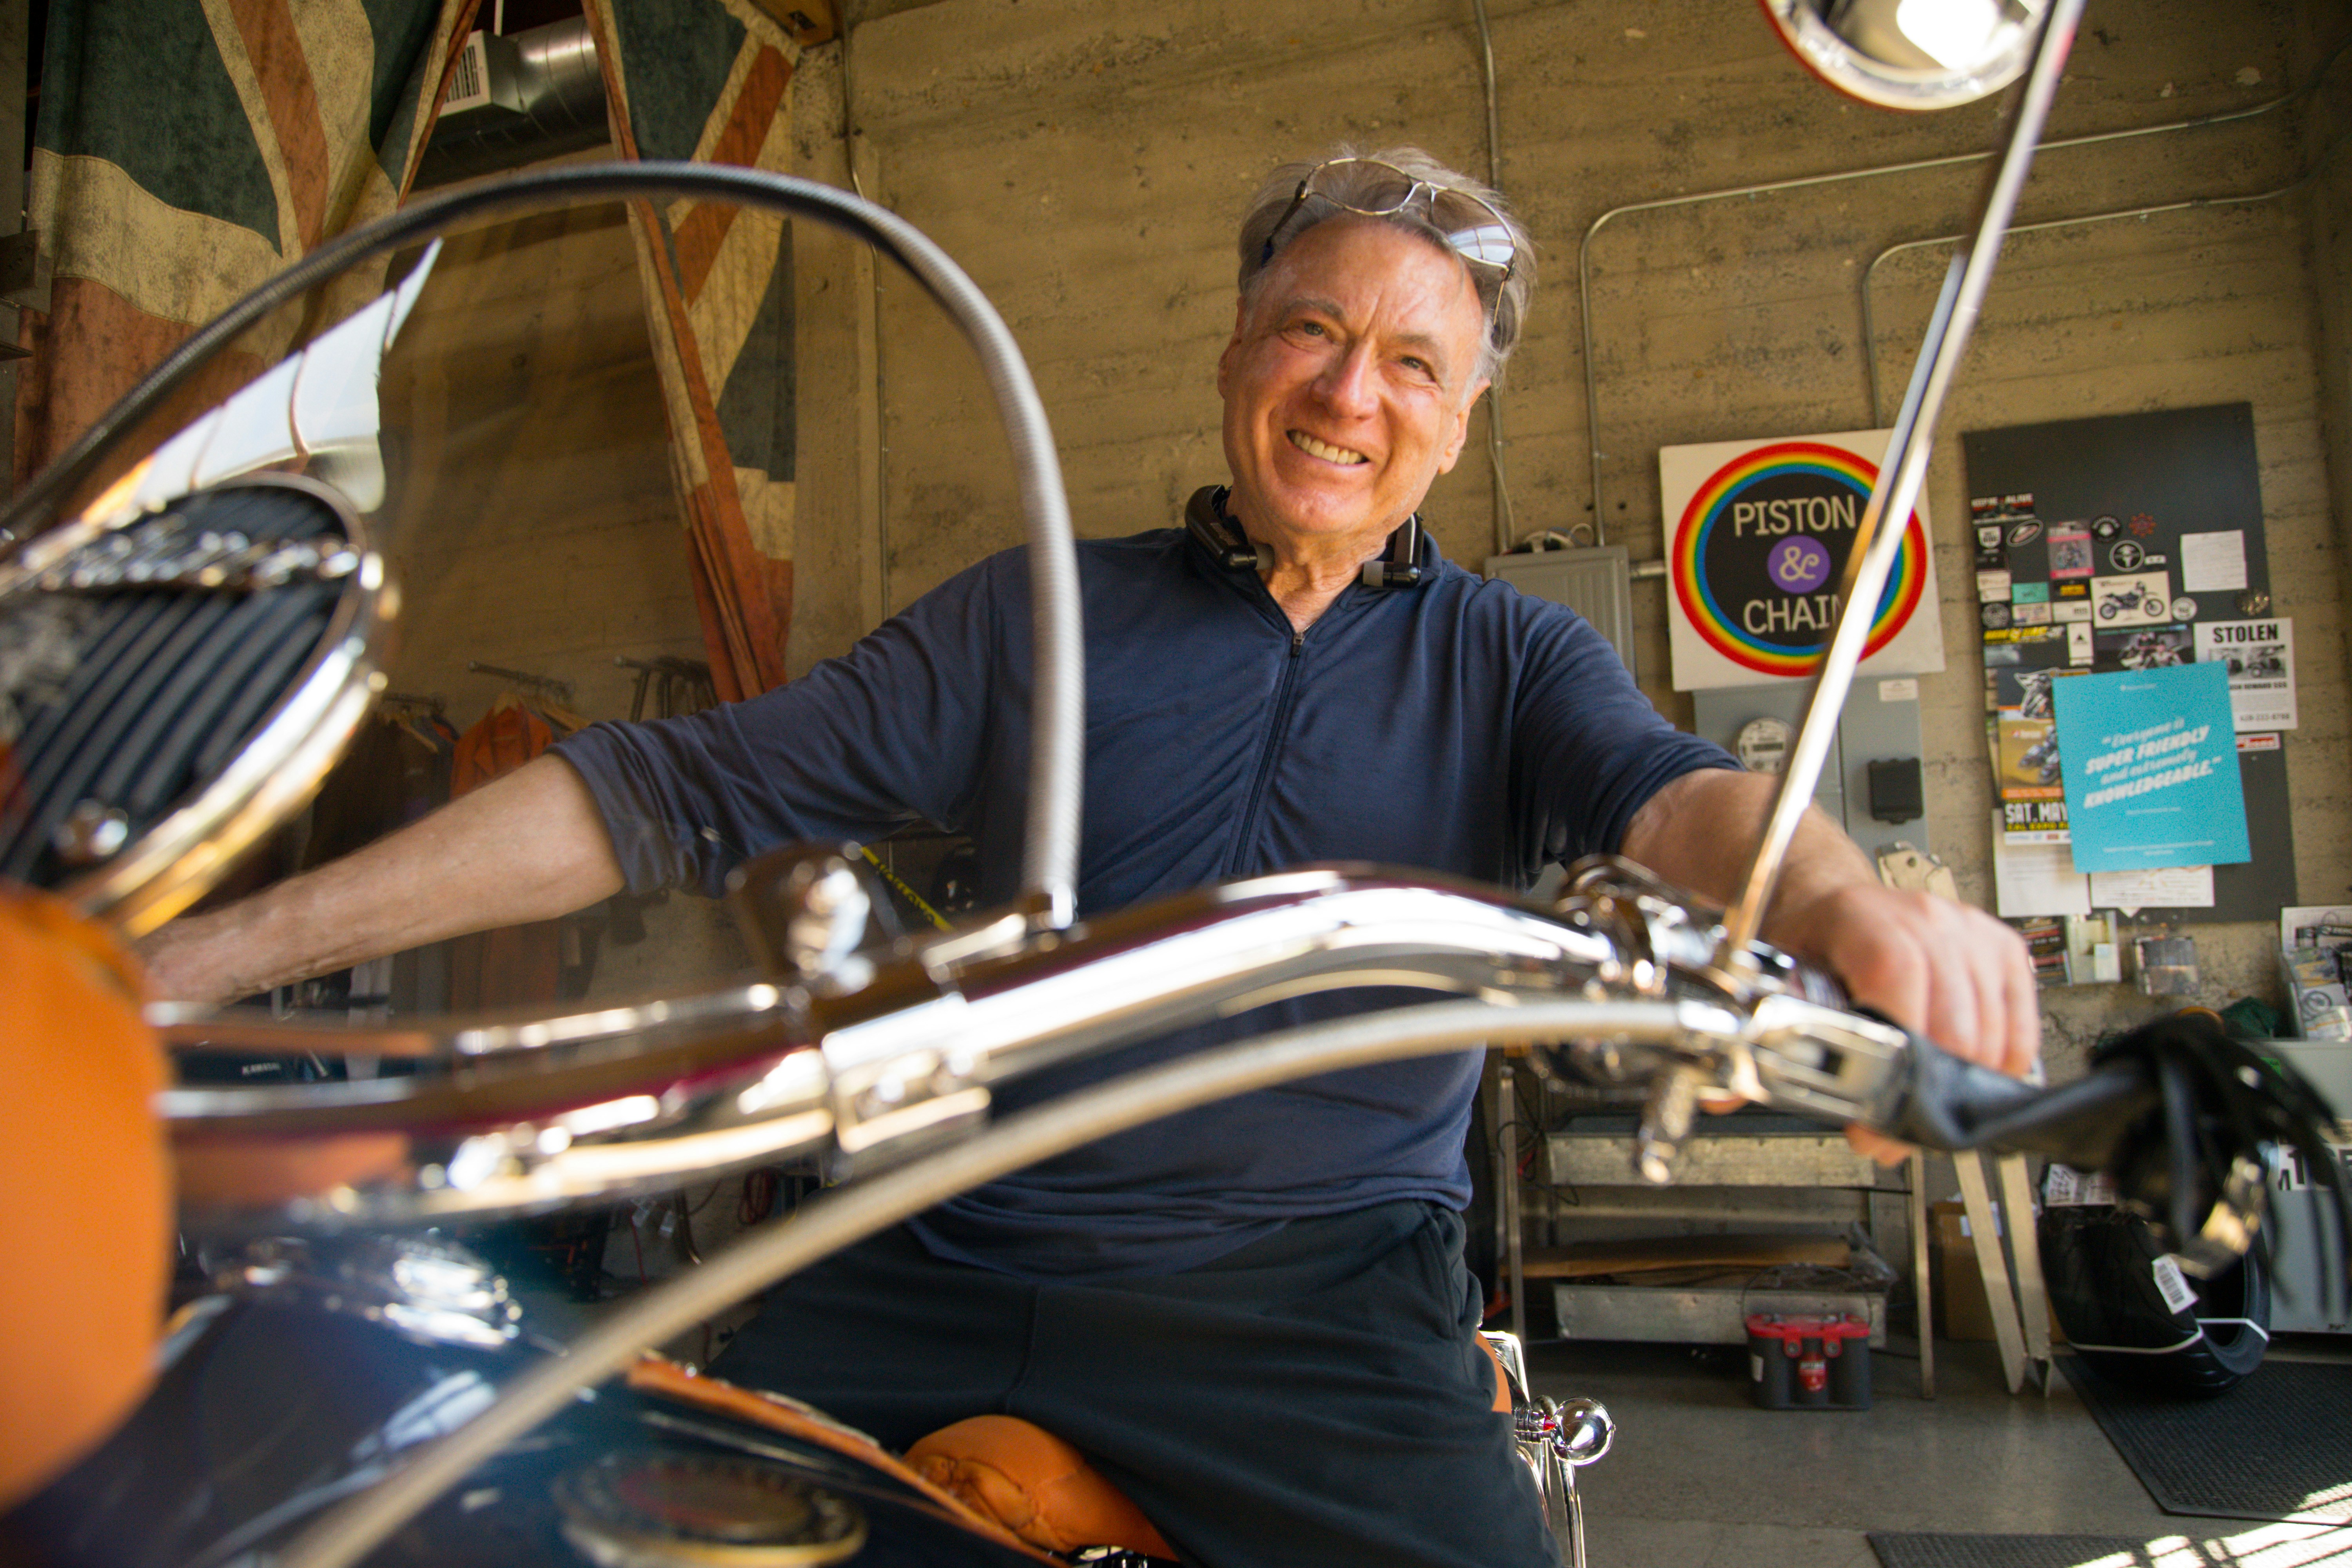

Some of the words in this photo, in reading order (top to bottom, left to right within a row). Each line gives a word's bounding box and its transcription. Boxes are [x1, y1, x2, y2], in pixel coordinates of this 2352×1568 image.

[1733, 494, 1857, 537] PISTON
[1779, 546, 1820, 582] &
[2213, 623, 2278, 643] STOLEN
[2085, 747, 2135, 775] SUPER
[2137, 725, 2210, 760] FRIENDLY
